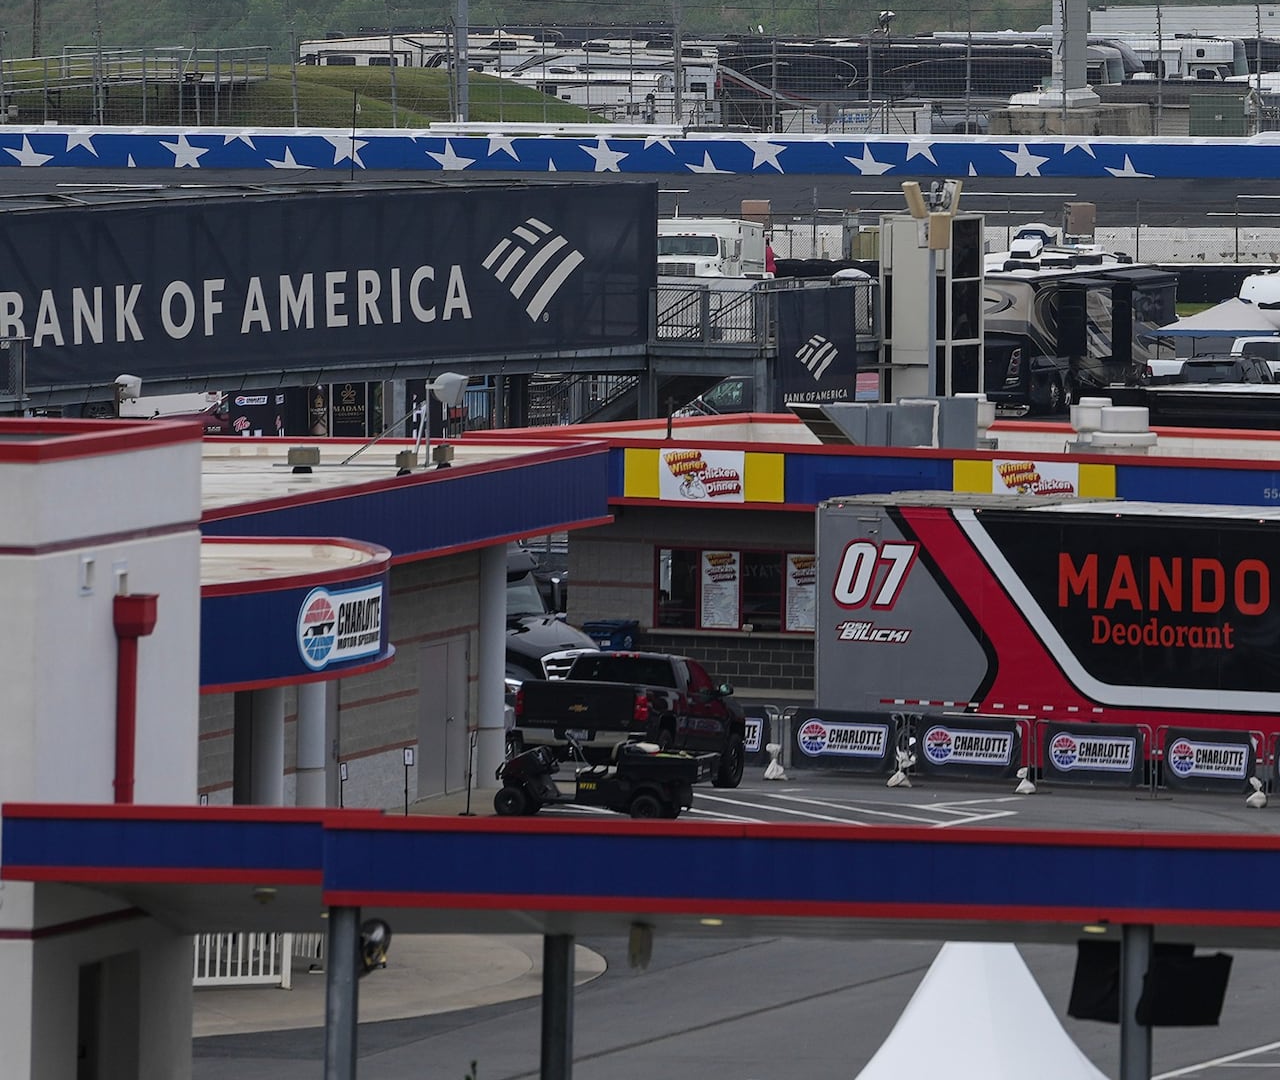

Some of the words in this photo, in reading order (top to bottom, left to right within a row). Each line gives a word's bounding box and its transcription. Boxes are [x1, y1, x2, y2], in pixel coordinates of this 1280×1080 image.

[0, 284, 144, 347] BANK
[161, 278, 225, 340] OF
[241, 265, 472, 333] AMERICA
[784, 392, 804, 403] BANK
[806, 392, 814, 400] OF
[815, 389, 848, 401] AMERICA
[665, 451, 699, 464] Winner
[670, 461, 705, 474] Winner
[698, 467, 737, 481] Chicken
[998, 462, 1033, 475] Winner
[1003, 472, 1038, 485] Winner
[707, 480, 738, 493] Dinner
[1032, 480, 1071, 493] Chicken
[833, 538, 919, 610] 07
[1058, 553, 1270, 615] MANDO
[337, 595, 381, 635] CHARLOTTE
[838, 621, 872, 631] JOSH
[1092, 615, 1234, 649] Deodorant
[841, 627, 911, 642] BILICKI
[828, 728, 882, 746] CHARLOTTE
[953, 735, 1007, 753] CHARLOTTE
[974, 752, 1005, 760] SPEEDWAY
[1078, 741, 1130, 758] CHARLOTTE
[1195, 748, 1244, 766] CHARLOTTE
